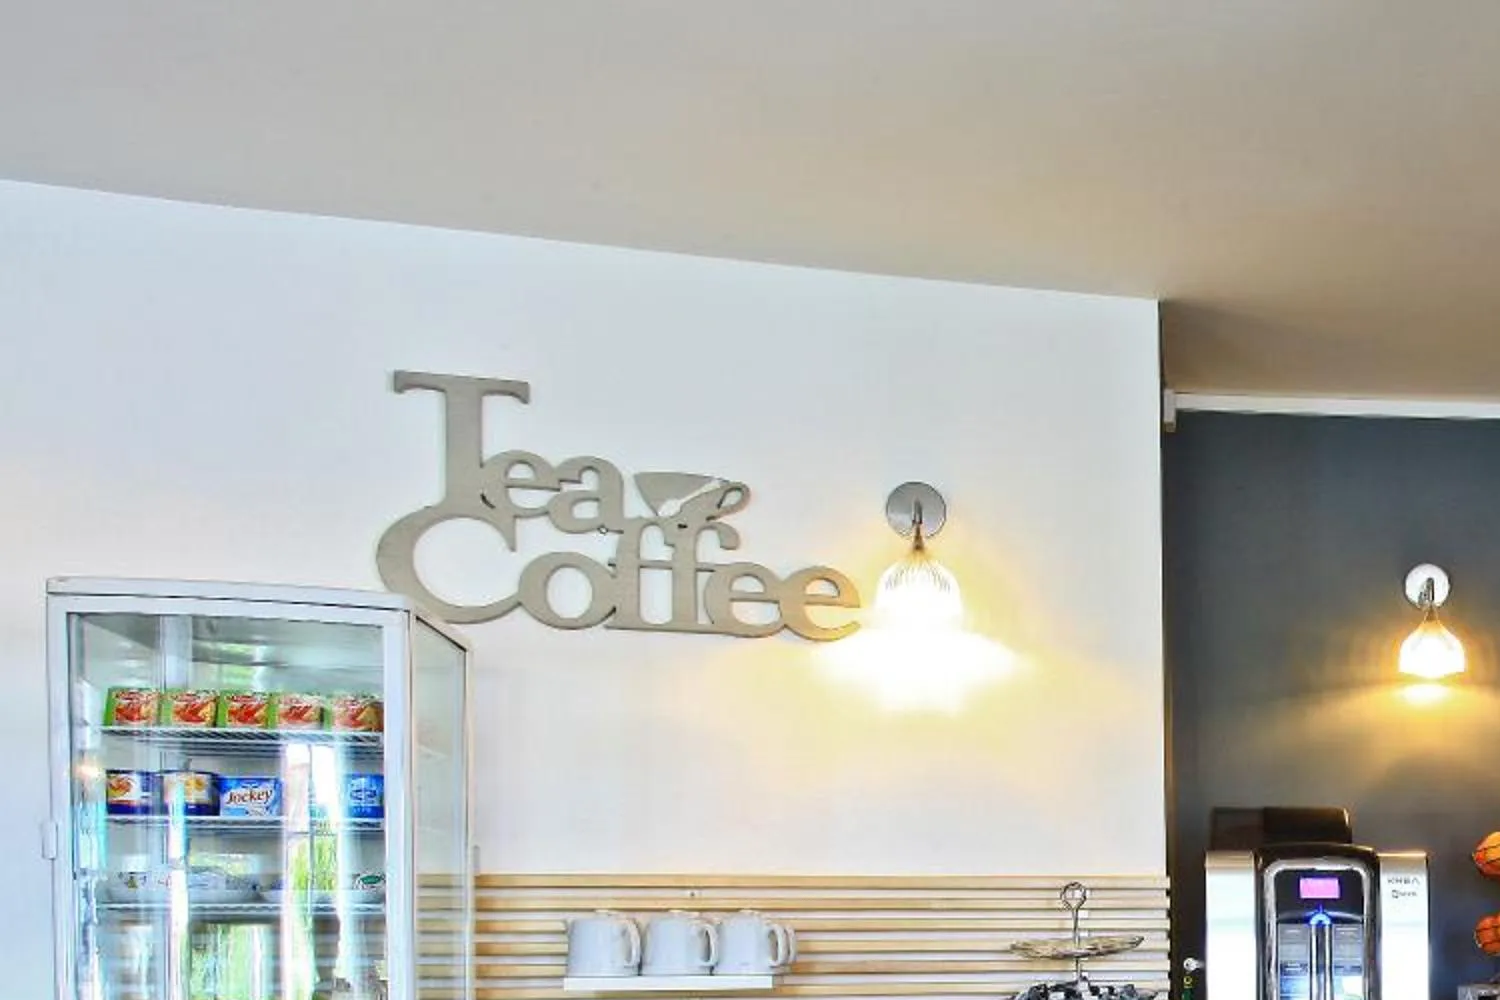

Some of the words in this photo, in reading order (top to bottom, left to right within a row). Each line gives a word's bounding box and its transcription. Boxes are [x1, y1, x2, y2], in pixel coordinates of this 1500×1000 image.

[393, 369, 625, 534] Tea
[376, 503, 862, 643] Coffee
[226, 789, 273, 805] Jockey
